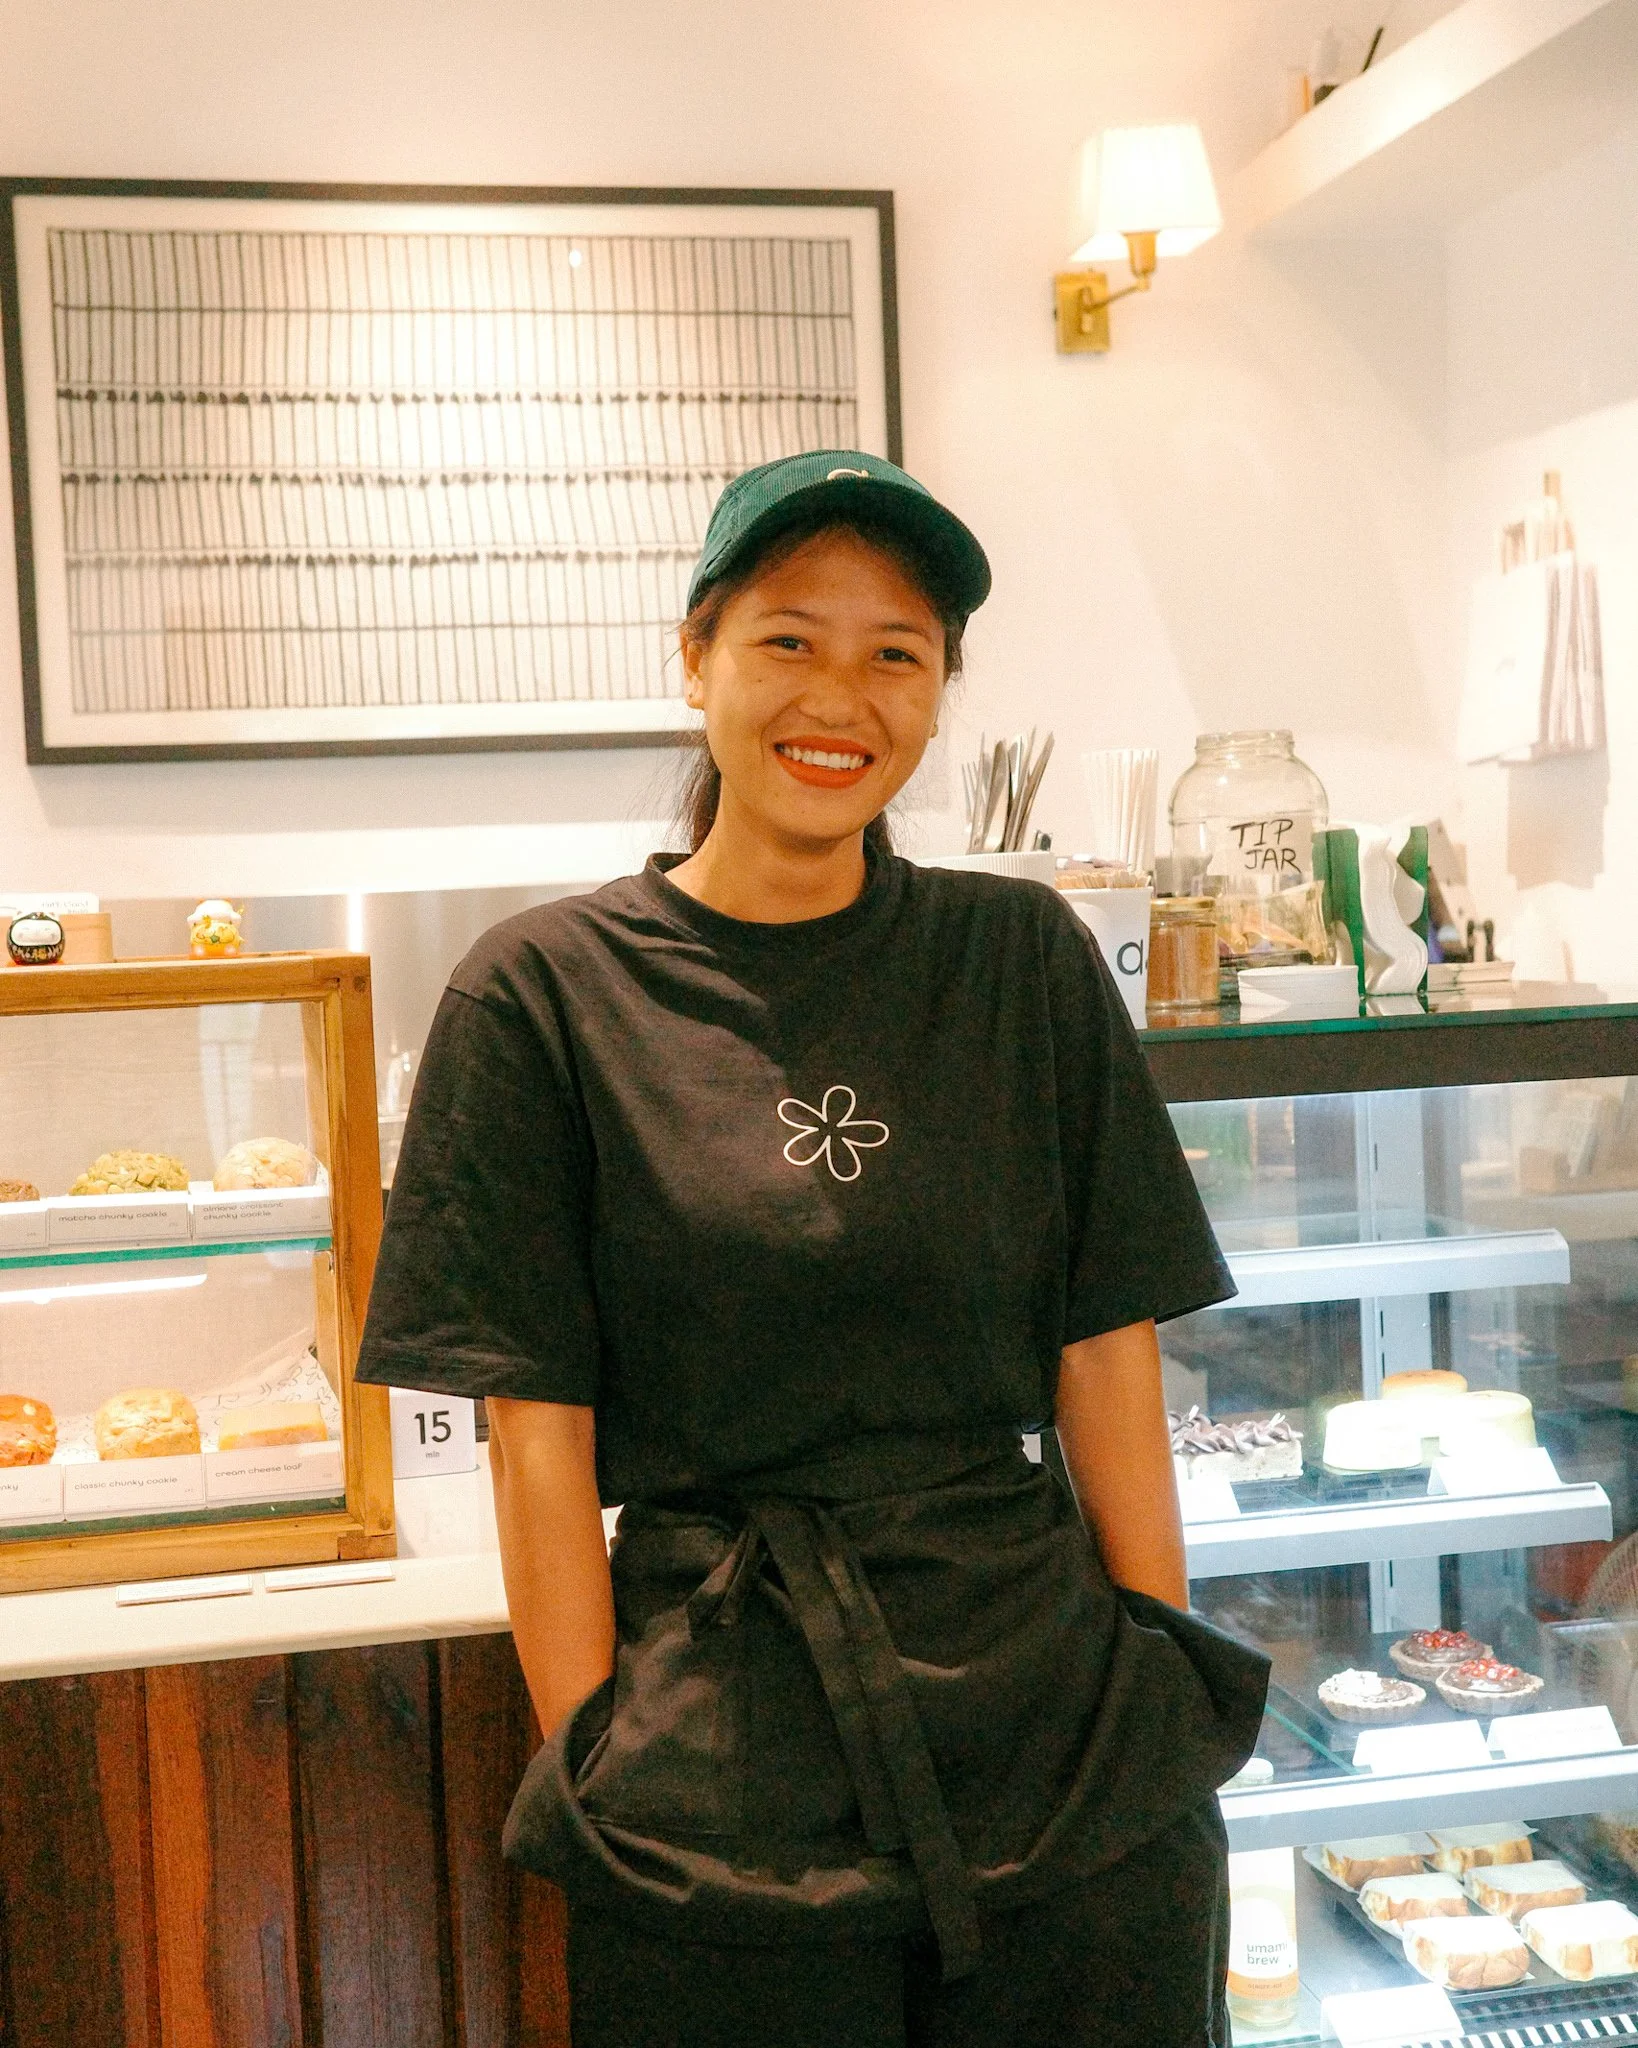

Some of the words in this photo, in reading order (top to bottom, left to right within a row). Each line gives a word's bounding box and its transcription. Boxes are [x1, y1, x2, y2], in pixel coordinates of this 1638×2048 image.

[1229, 818, 1294, 848] TIP
[1244, 848, 1302, 873] JAR
[1116, 939, 1148, 976] a
[202, 1204, 238, 1212] almond
[58, 1213, 97, 1222] matcha
[99, 1212, 134, 1221] chunky
[136, 1210, 168, 1219] cookie
[203, 1212, 238, 1221] chunky
[240, 1210, 272, 1218] cookie
[413, 1409, 452, 1445] 15
[425, 1450, 441, 1459] min
[214, 1469, 246, 1478] cream
[248, 1465, 281, 1474] cheese
[283, 1462, 303, 1471] loaf
[0, 1483, 19, 1492] nky
[74, 1480, 107, 1490] classic
[108, 1479, 144, 1488] chunky
[146, 1476, 178, 1485] cookie
[1246, 1953, 1280, 1965] brew
